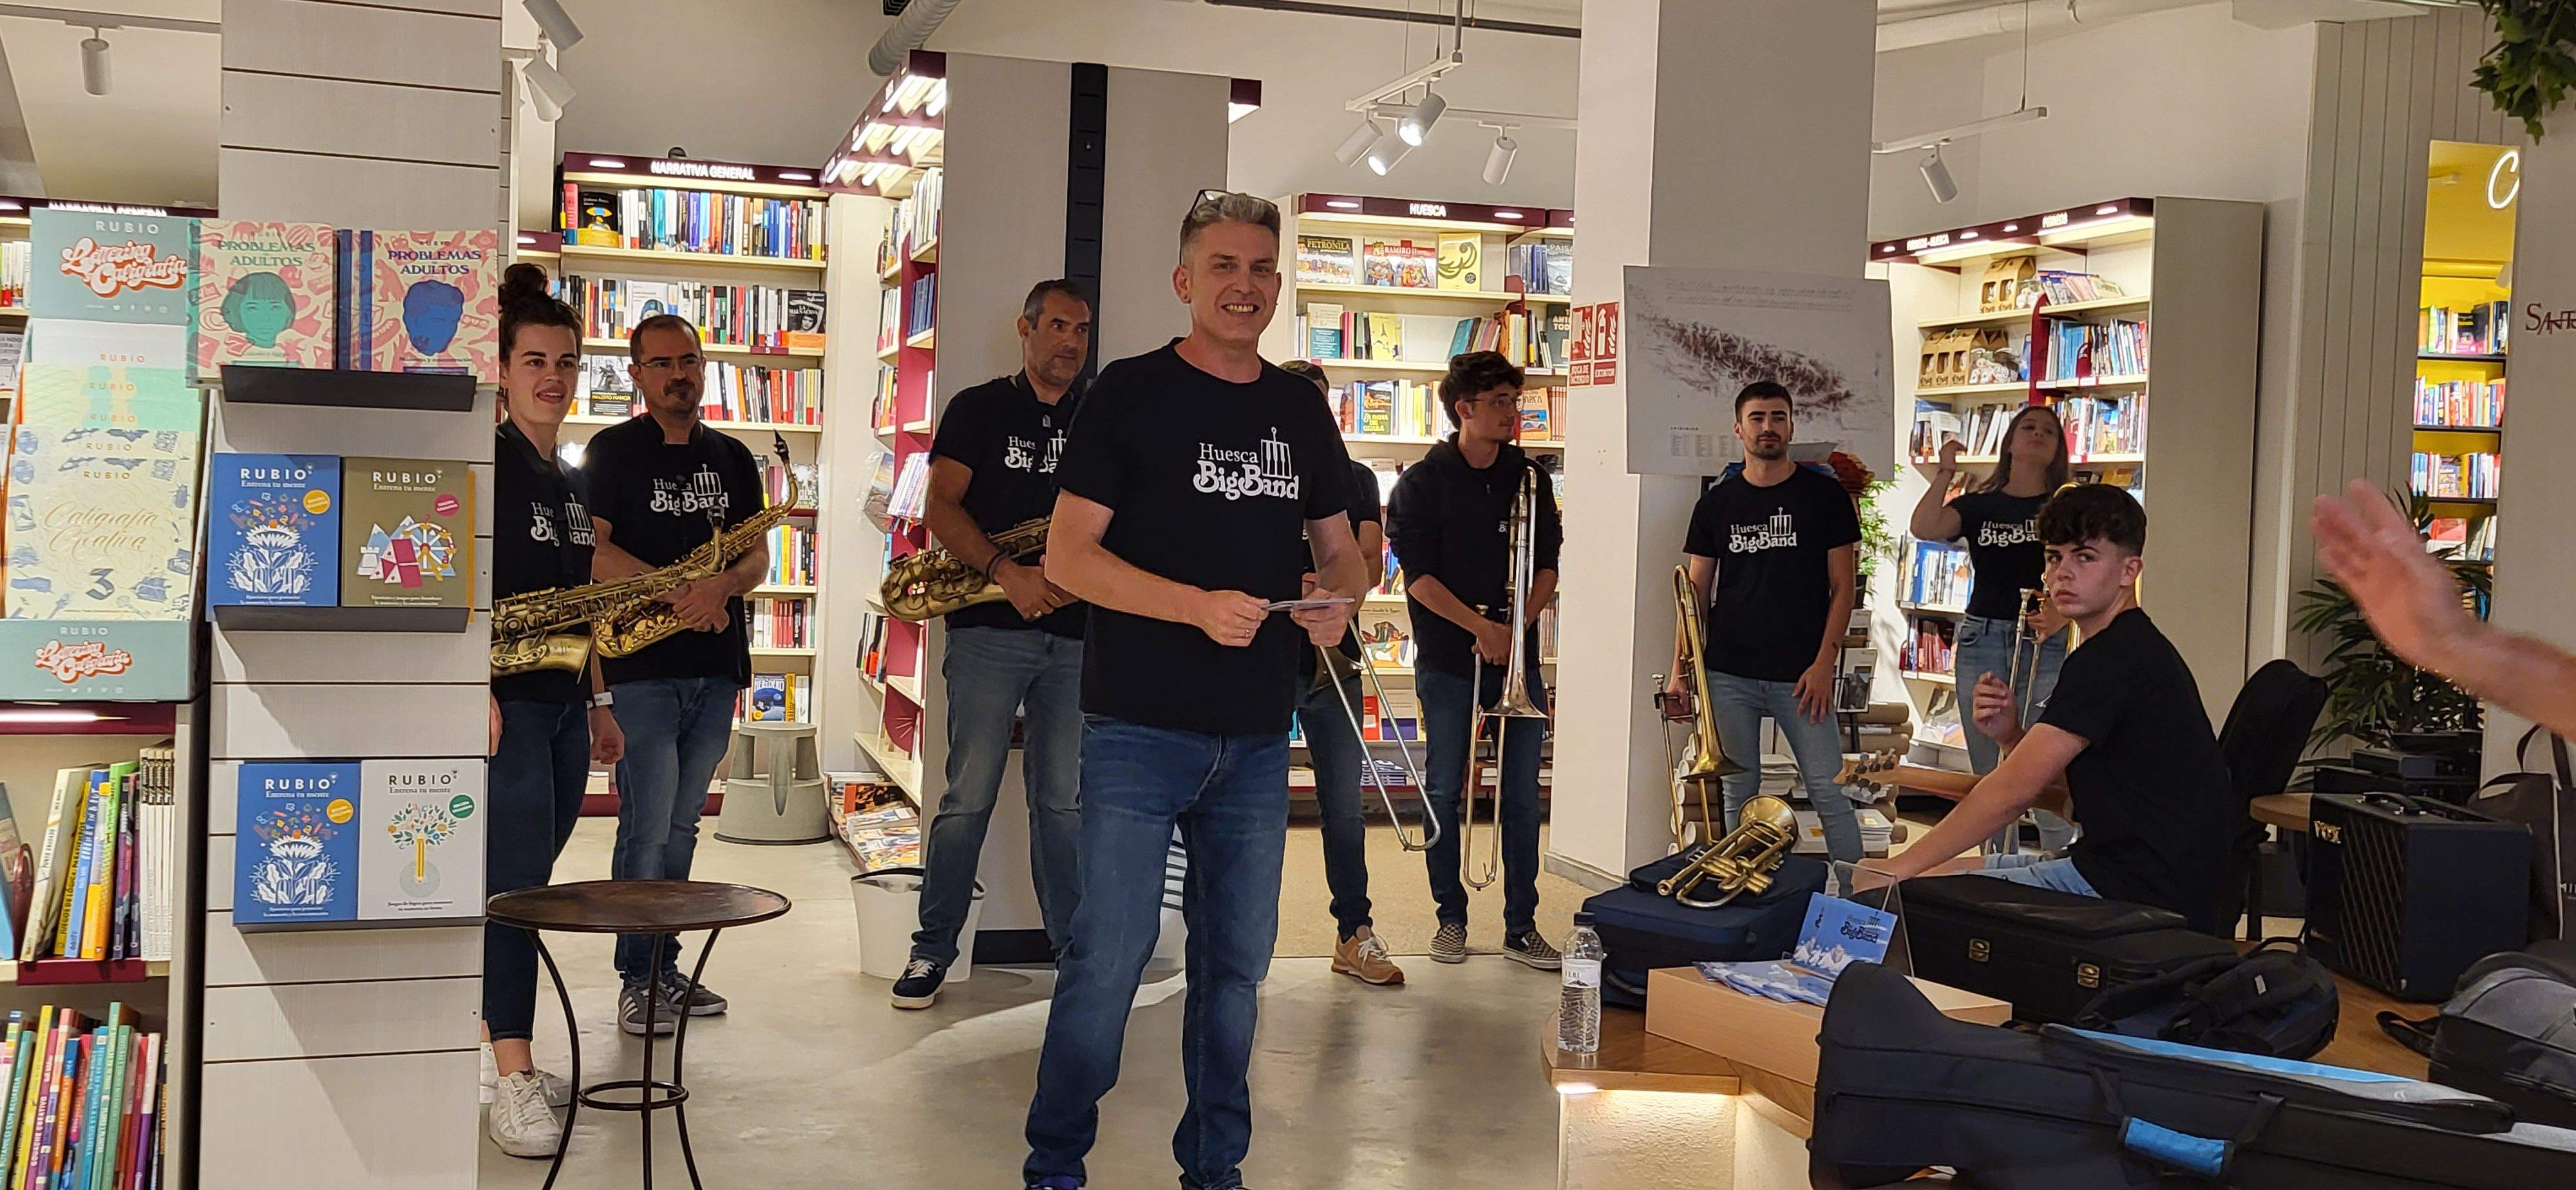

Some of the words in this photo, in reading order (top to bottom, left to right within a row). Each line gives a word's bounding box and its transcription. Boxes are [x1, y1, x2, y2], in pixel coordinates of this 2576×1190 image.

[650, 161, 708, 177] NARRATIVA
[709, 165, 755, 180] GENERAL
[1410, 203, 1447, 217] HUESCA
[95, 220, 159, 234] RUBIO
[217, 240, 316, 252] PROBLEMAS
[1307, 240, 1351, 251] PETRONILA
[388, 250, 482, 260] PROBLEMAS
[1385, 247, 1411, 256] RAMIRO
[230, 256, 303, 267] ADULTOS
[399, 264, 470, 275] ADULTOS
[100, 354, 145, 363] RUBIO
[90, 382, 134, 392] RUBIO
[90, 413, 135, 422] RUBIO
[86, 442, 132, 451] RUBIO
[1199, 442, 1258, 463] Huesca
[84, 470, 130, 480] RUBIO
[240, 468, 307, 480] RUBIO
[372, 471, 437, 484] RUBIO
[1193, 460, 1299, 500] BigBand
[1730, 524, 1768, 534] Huesca
[1728, 531, 1797, 553] BigBand
[86, 568, 115, 601] 3
[59, 627, 109, 636] RUBIO
[265, 779, 330, 790] RUBIO
[389, 775, 451, 785] RUBIO
